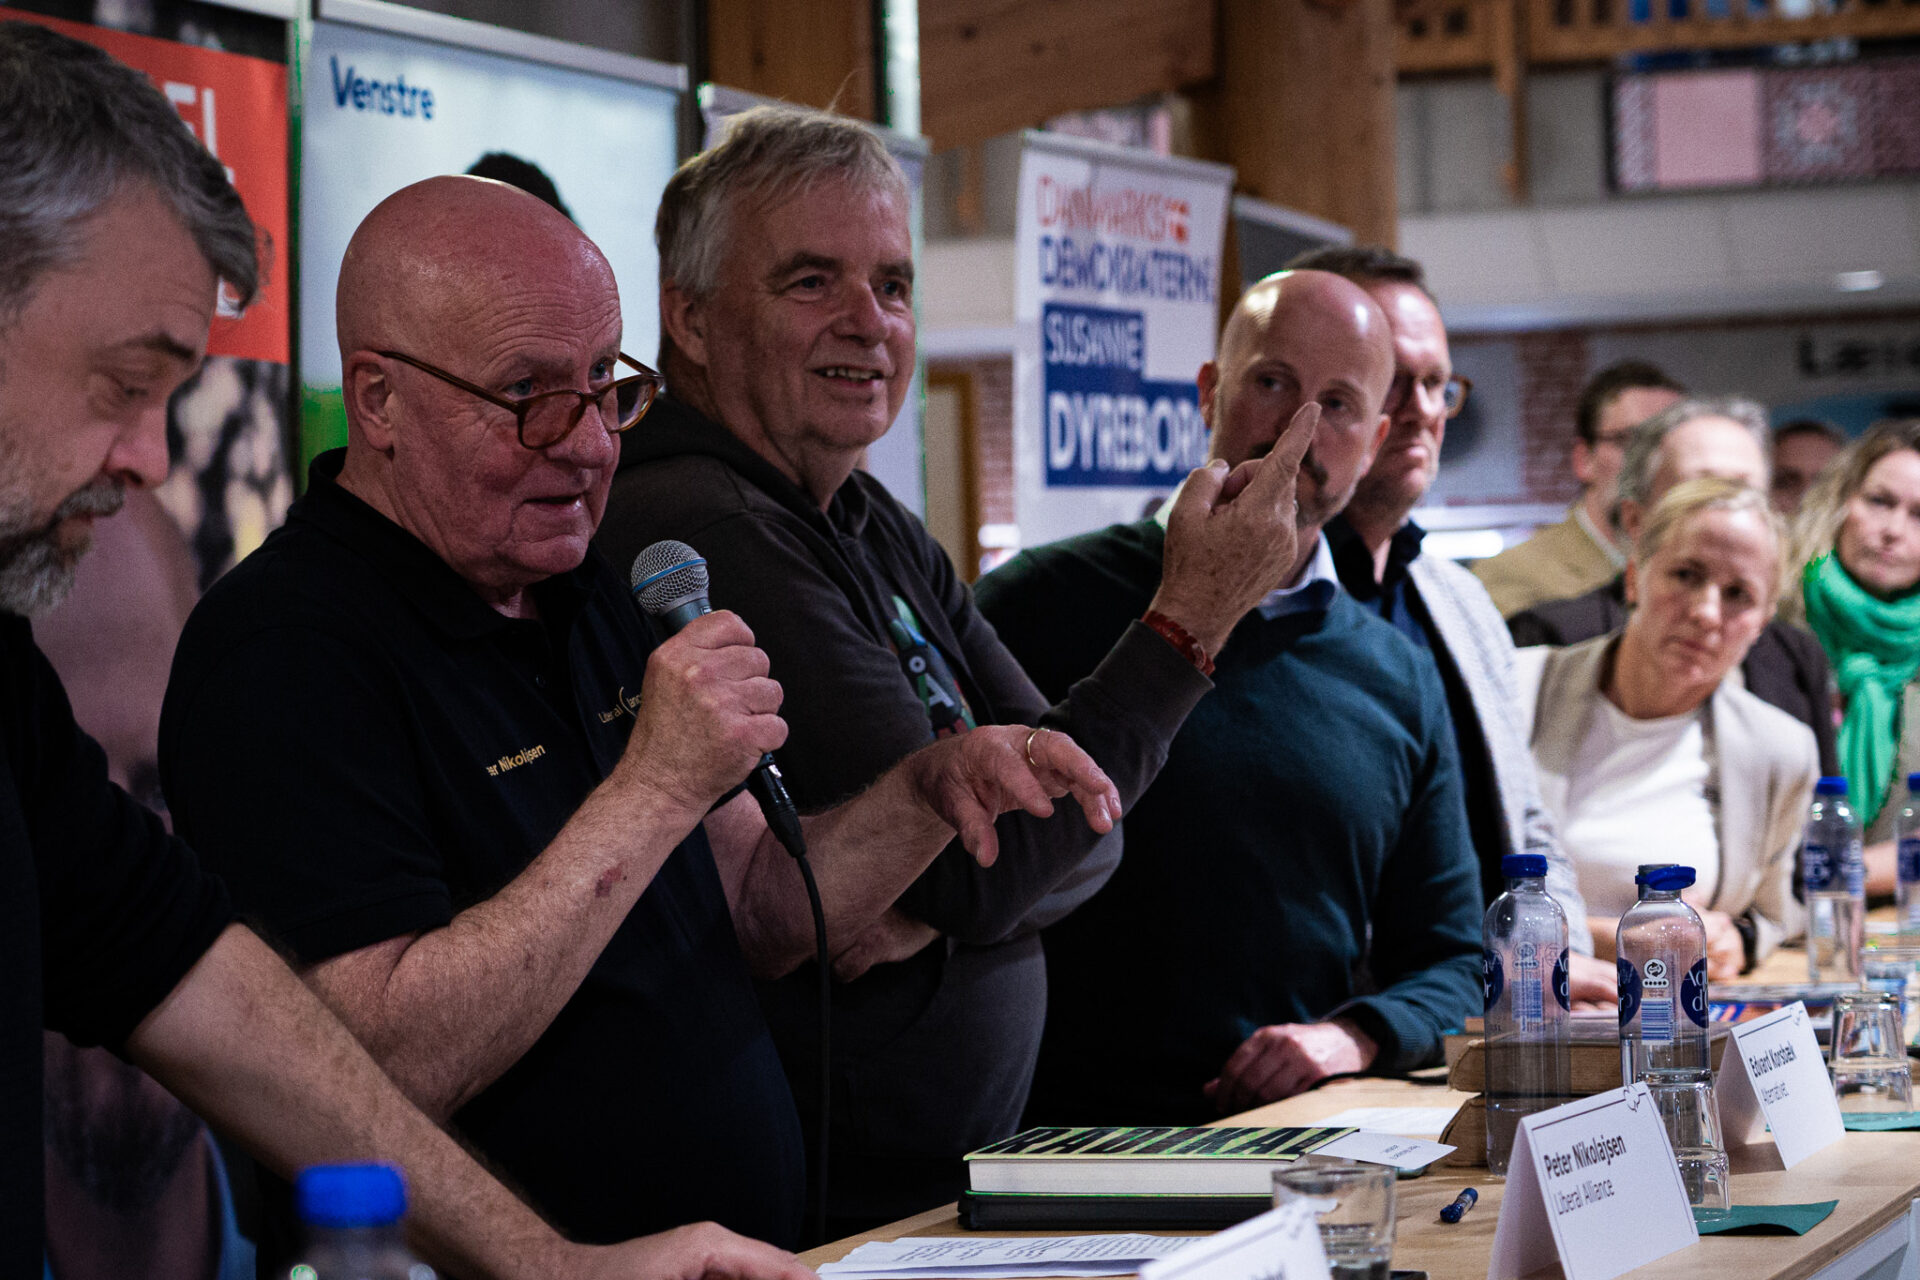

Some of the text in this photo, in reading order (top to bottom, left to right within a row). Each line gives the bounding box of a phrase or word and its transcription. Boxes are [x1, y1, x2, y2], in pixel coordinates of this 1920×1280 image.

[330, 56, 434, 120] Venstre
[1544, 1135, 1626, 1179] Peter Nikolajsen
[1554, 1179, 1615, 1215] Liberal Alliance
